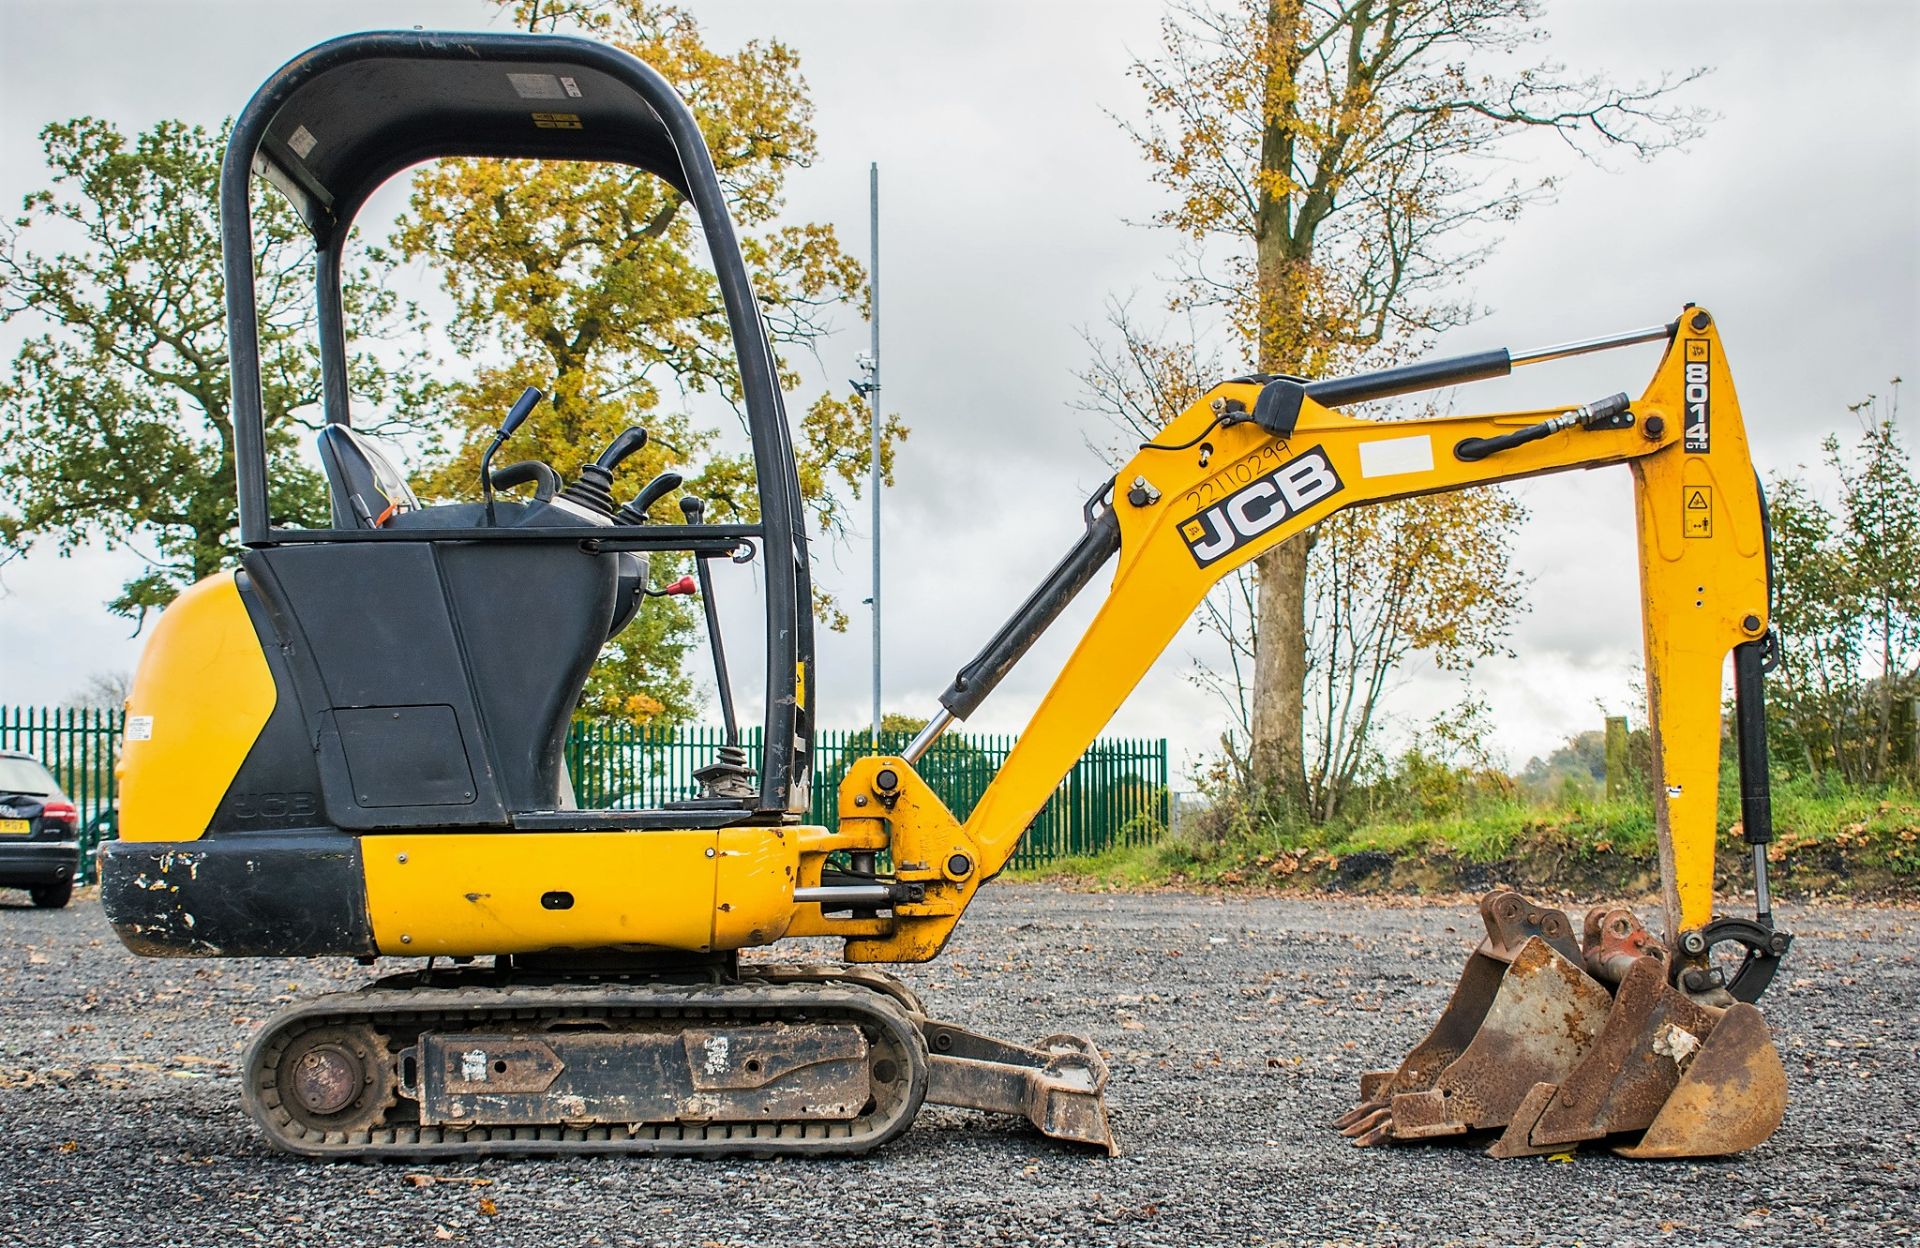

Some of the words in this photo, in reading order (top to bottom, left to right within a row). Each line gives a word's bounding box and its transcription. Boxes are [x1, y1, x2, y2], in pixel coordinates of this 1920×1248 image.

[1686, 363, 1709, 442] 8014
[1186, 440, 1294, 512] 22110299
[1193, 454, 1337, 561] JCB
